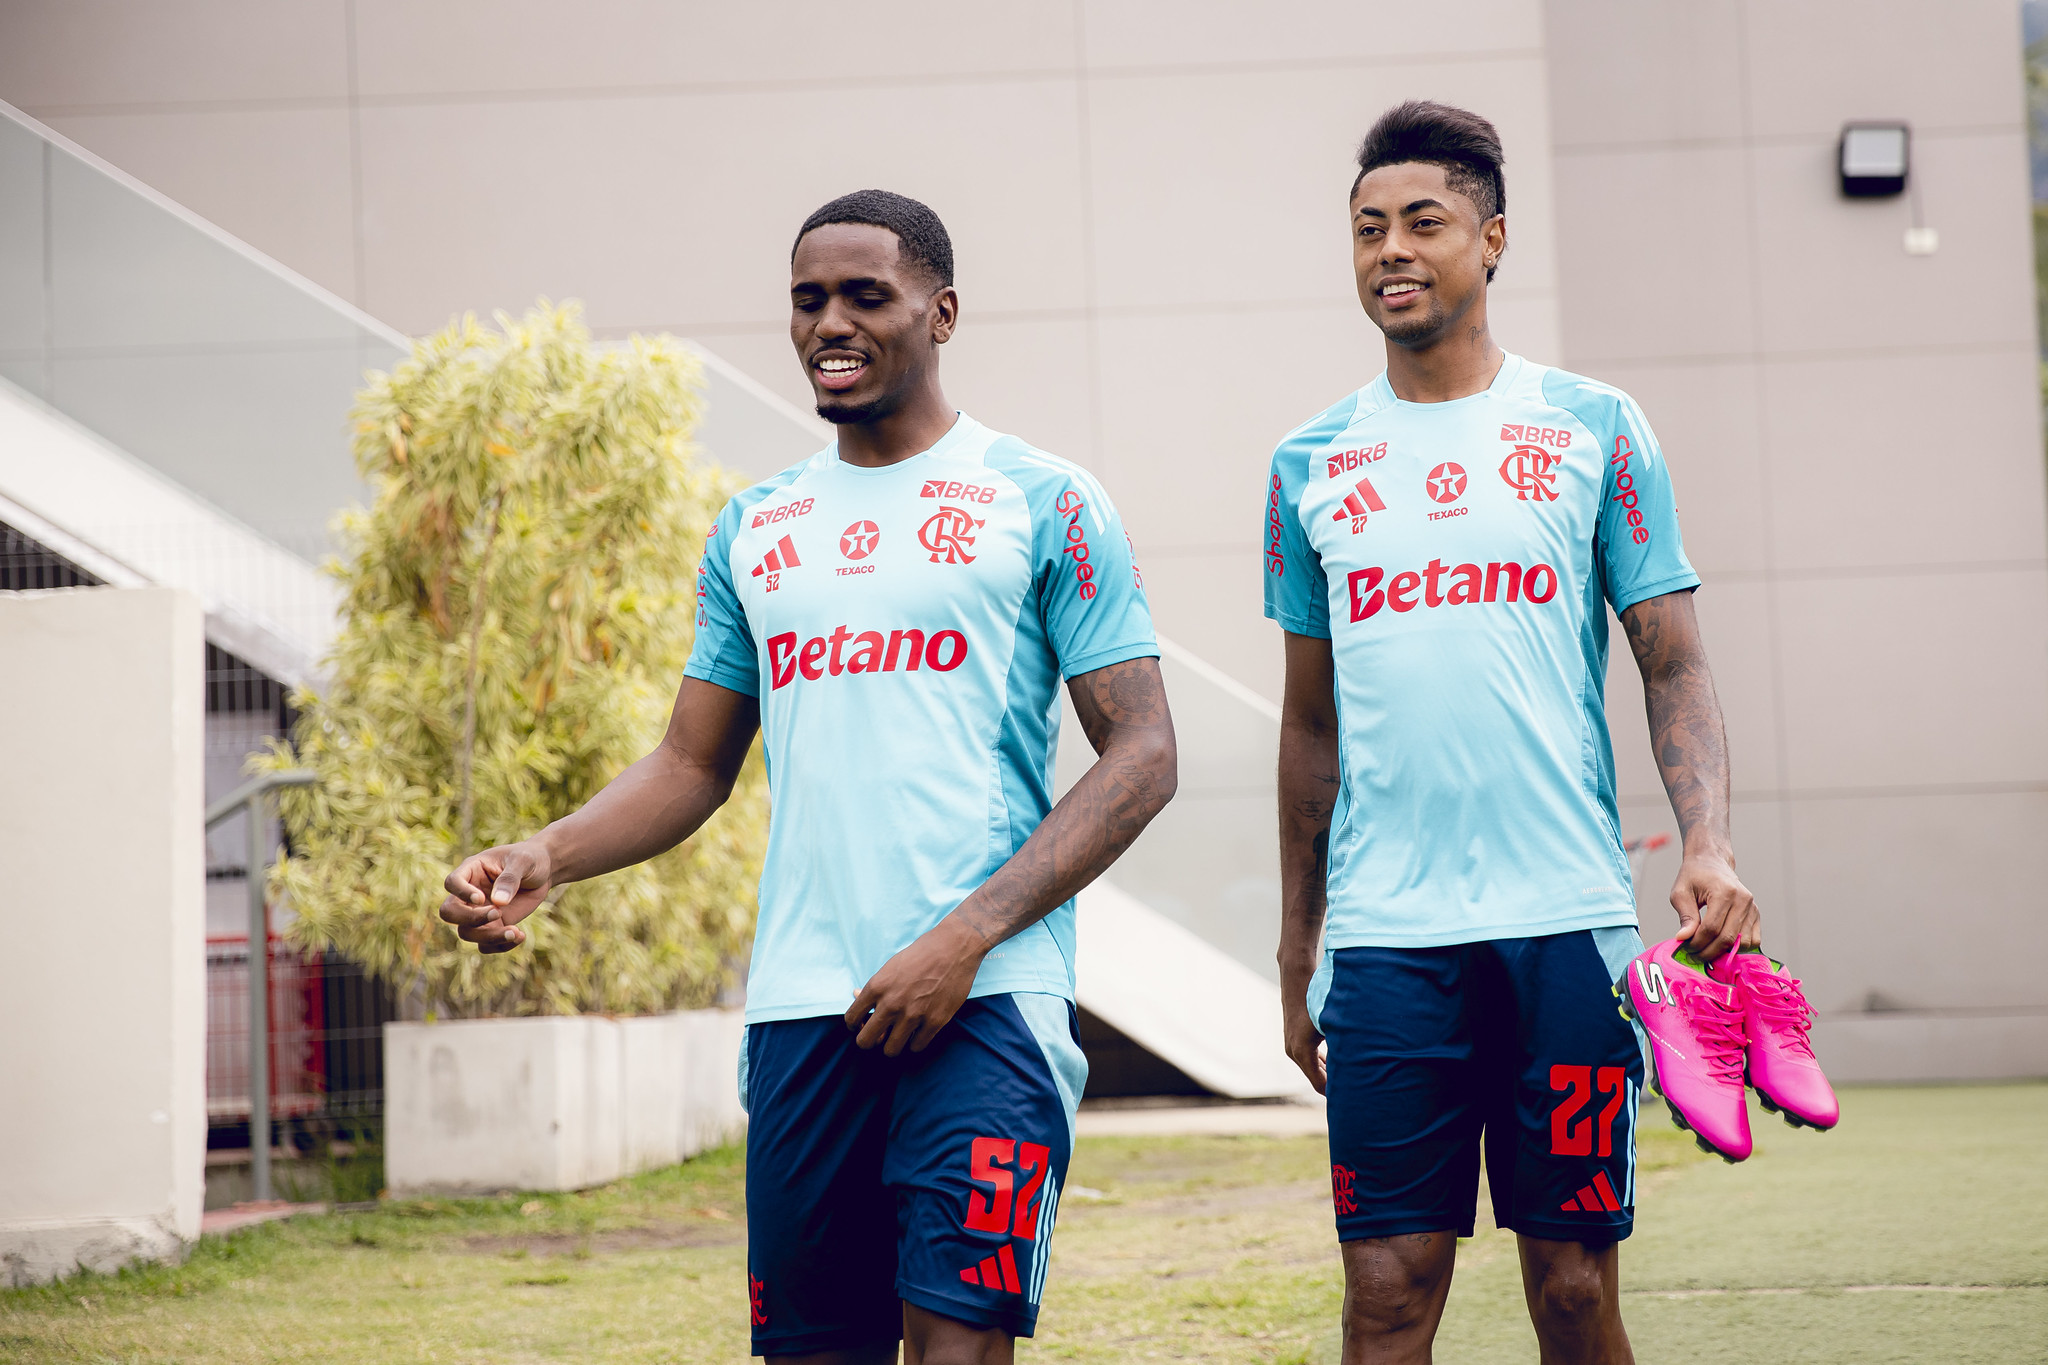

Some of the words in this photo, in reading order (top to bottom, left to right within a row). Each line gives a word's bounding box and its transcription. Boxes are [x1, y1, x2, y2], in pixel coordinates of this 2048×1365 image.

[1525, 426, 1572, 448] BRB
[1343, 442, 1388, 472] BRB
[944, 481, 997, 504] BRB
[1611, 434, 1649, 545] Shopee
[771, 498, 815, 524] BRB
[1265, 473, 1284, 577] Shopee
[1352, 515, 1368, 535] 27
[1427, 507, 1469, 521] TEXACO
[1056, 490, 1097, 601] Shopee
[765, 572, 780, 593] 52
[835, 564, 875, 576] TEXACO
[1347, 558, 1558, 624] Betano
[766, 624, 968, 691] Betano
[1550, 1064, 1627, 1158] 27
[963, 1137, 1051, 1241] 52
